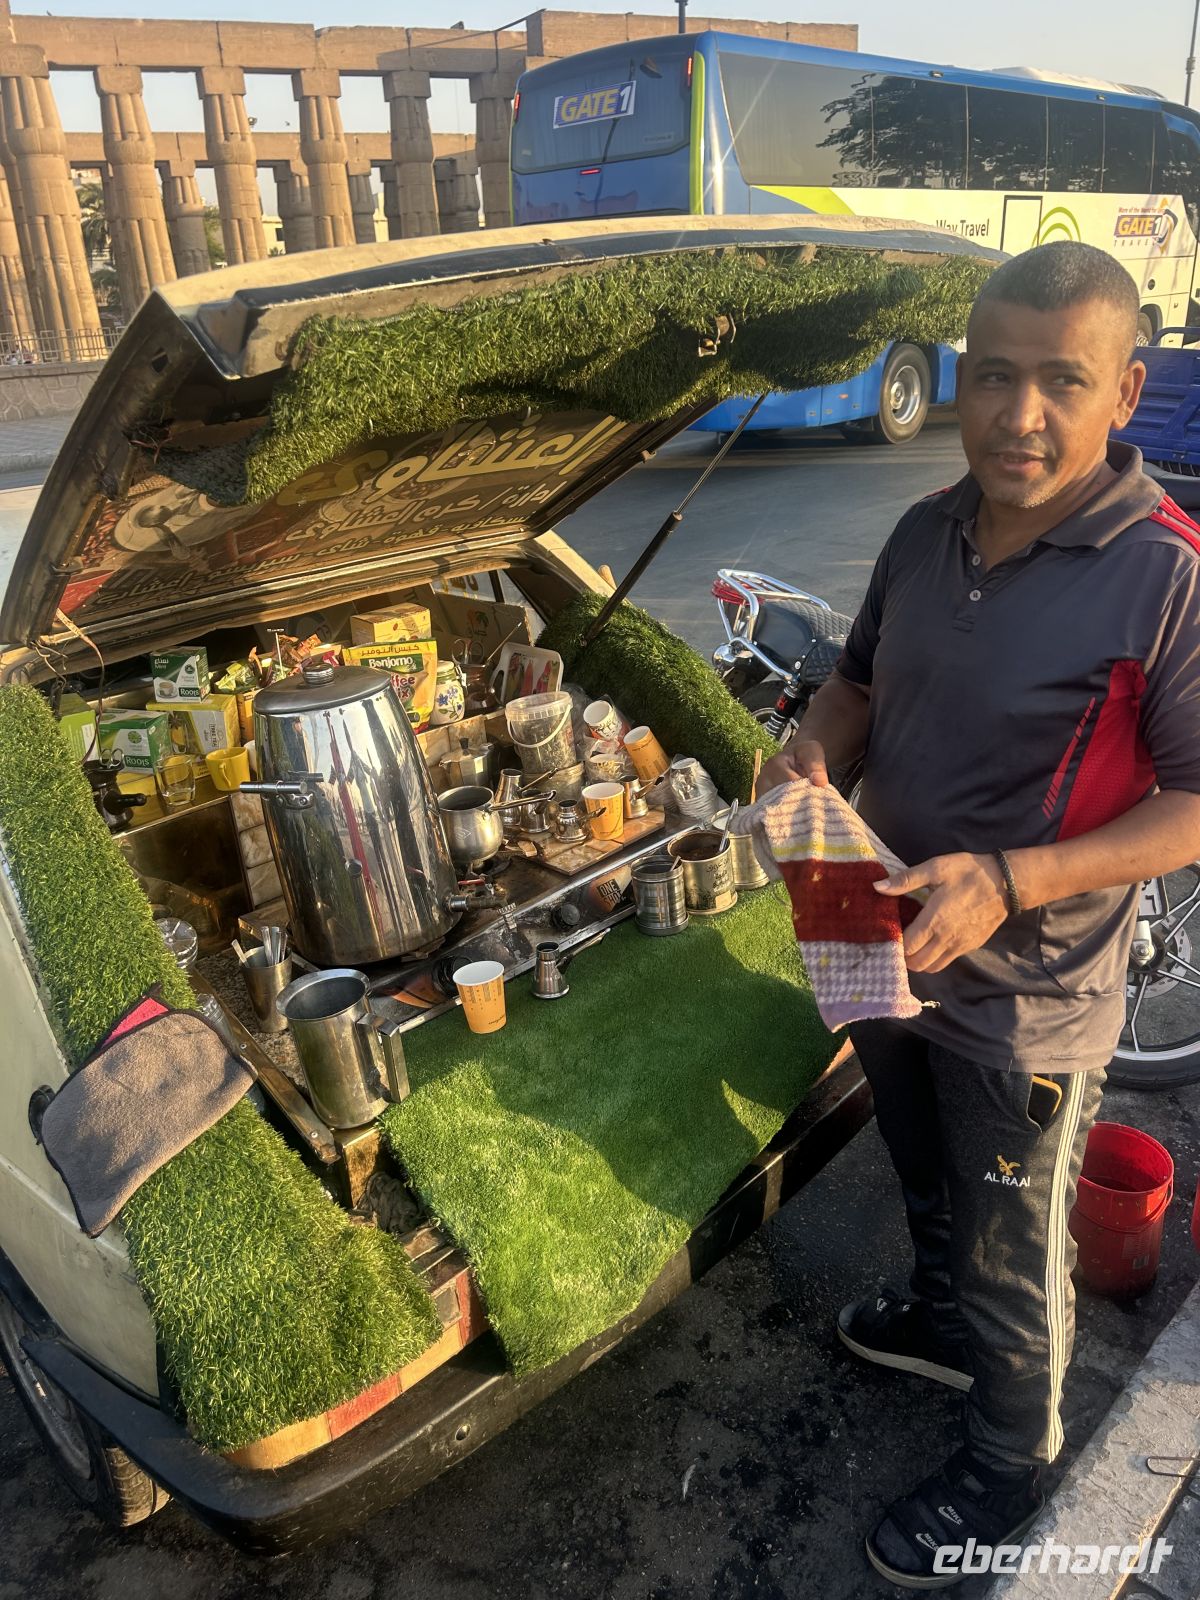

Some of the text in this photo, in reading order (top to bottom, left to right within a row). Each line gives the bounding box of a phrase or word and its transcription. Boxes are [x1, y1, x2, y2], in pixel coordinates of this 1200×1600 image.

[960, 218, 990, 237] Travel
[413, 494, 481, 523] كرم
[600, 880, 618, 897] ONE
